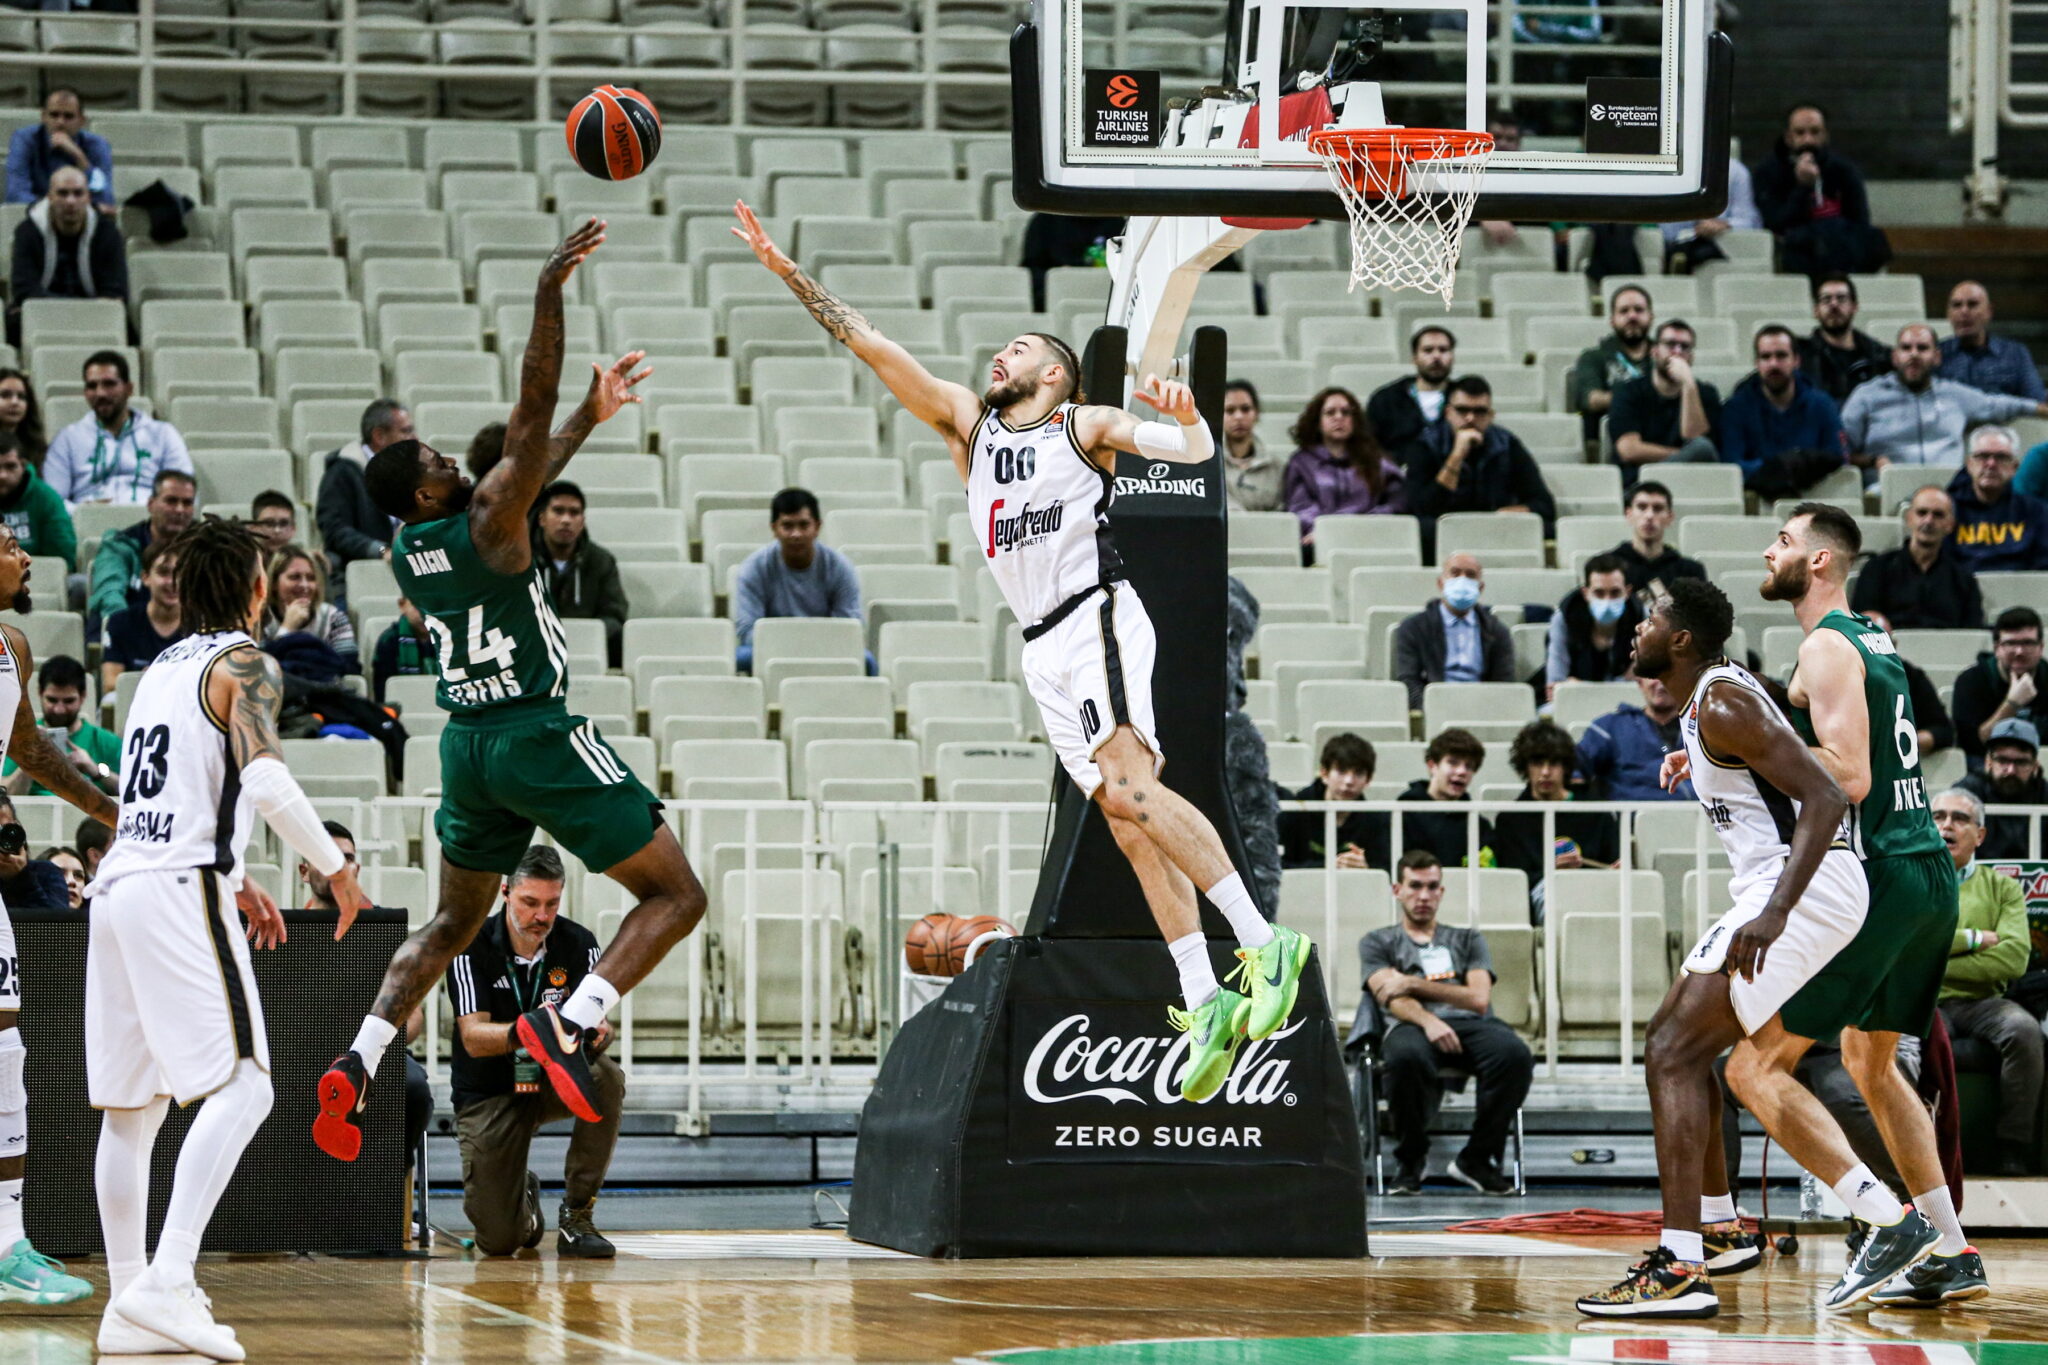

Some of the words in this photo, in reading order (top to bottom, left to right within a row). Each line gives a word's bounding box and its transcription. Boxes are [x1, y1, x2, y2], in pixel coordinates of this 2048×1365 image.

[1096, 121, 1149, 132] AIRLINES
[1097, 110, 1148, 121] TURKISH
[1608, 111, 1658, 121] oneteam
[1095, 132, 1150, 143] EuroLeague
[994, 446, 1036, 485] 00
[1115, 476, 1206, 498] SPALDING
[987, 499, 1064, 558] Segafredo
[1957, 521, 2025, 546] NAVY
[405, 548, 452, 577] BACON
[424, 604, 517, 683] 24
[1894, 694, 1919, 770] 6
[123, 724, 170, 804] 23
[1893, 776, 1927, 812] ATHE
[1023, 1014, 1307, 1105] Coca-Cla
[1055, 1126, 1140, 1147] ZERO
[1153, 1126, 1262, 1147] SUGAR
